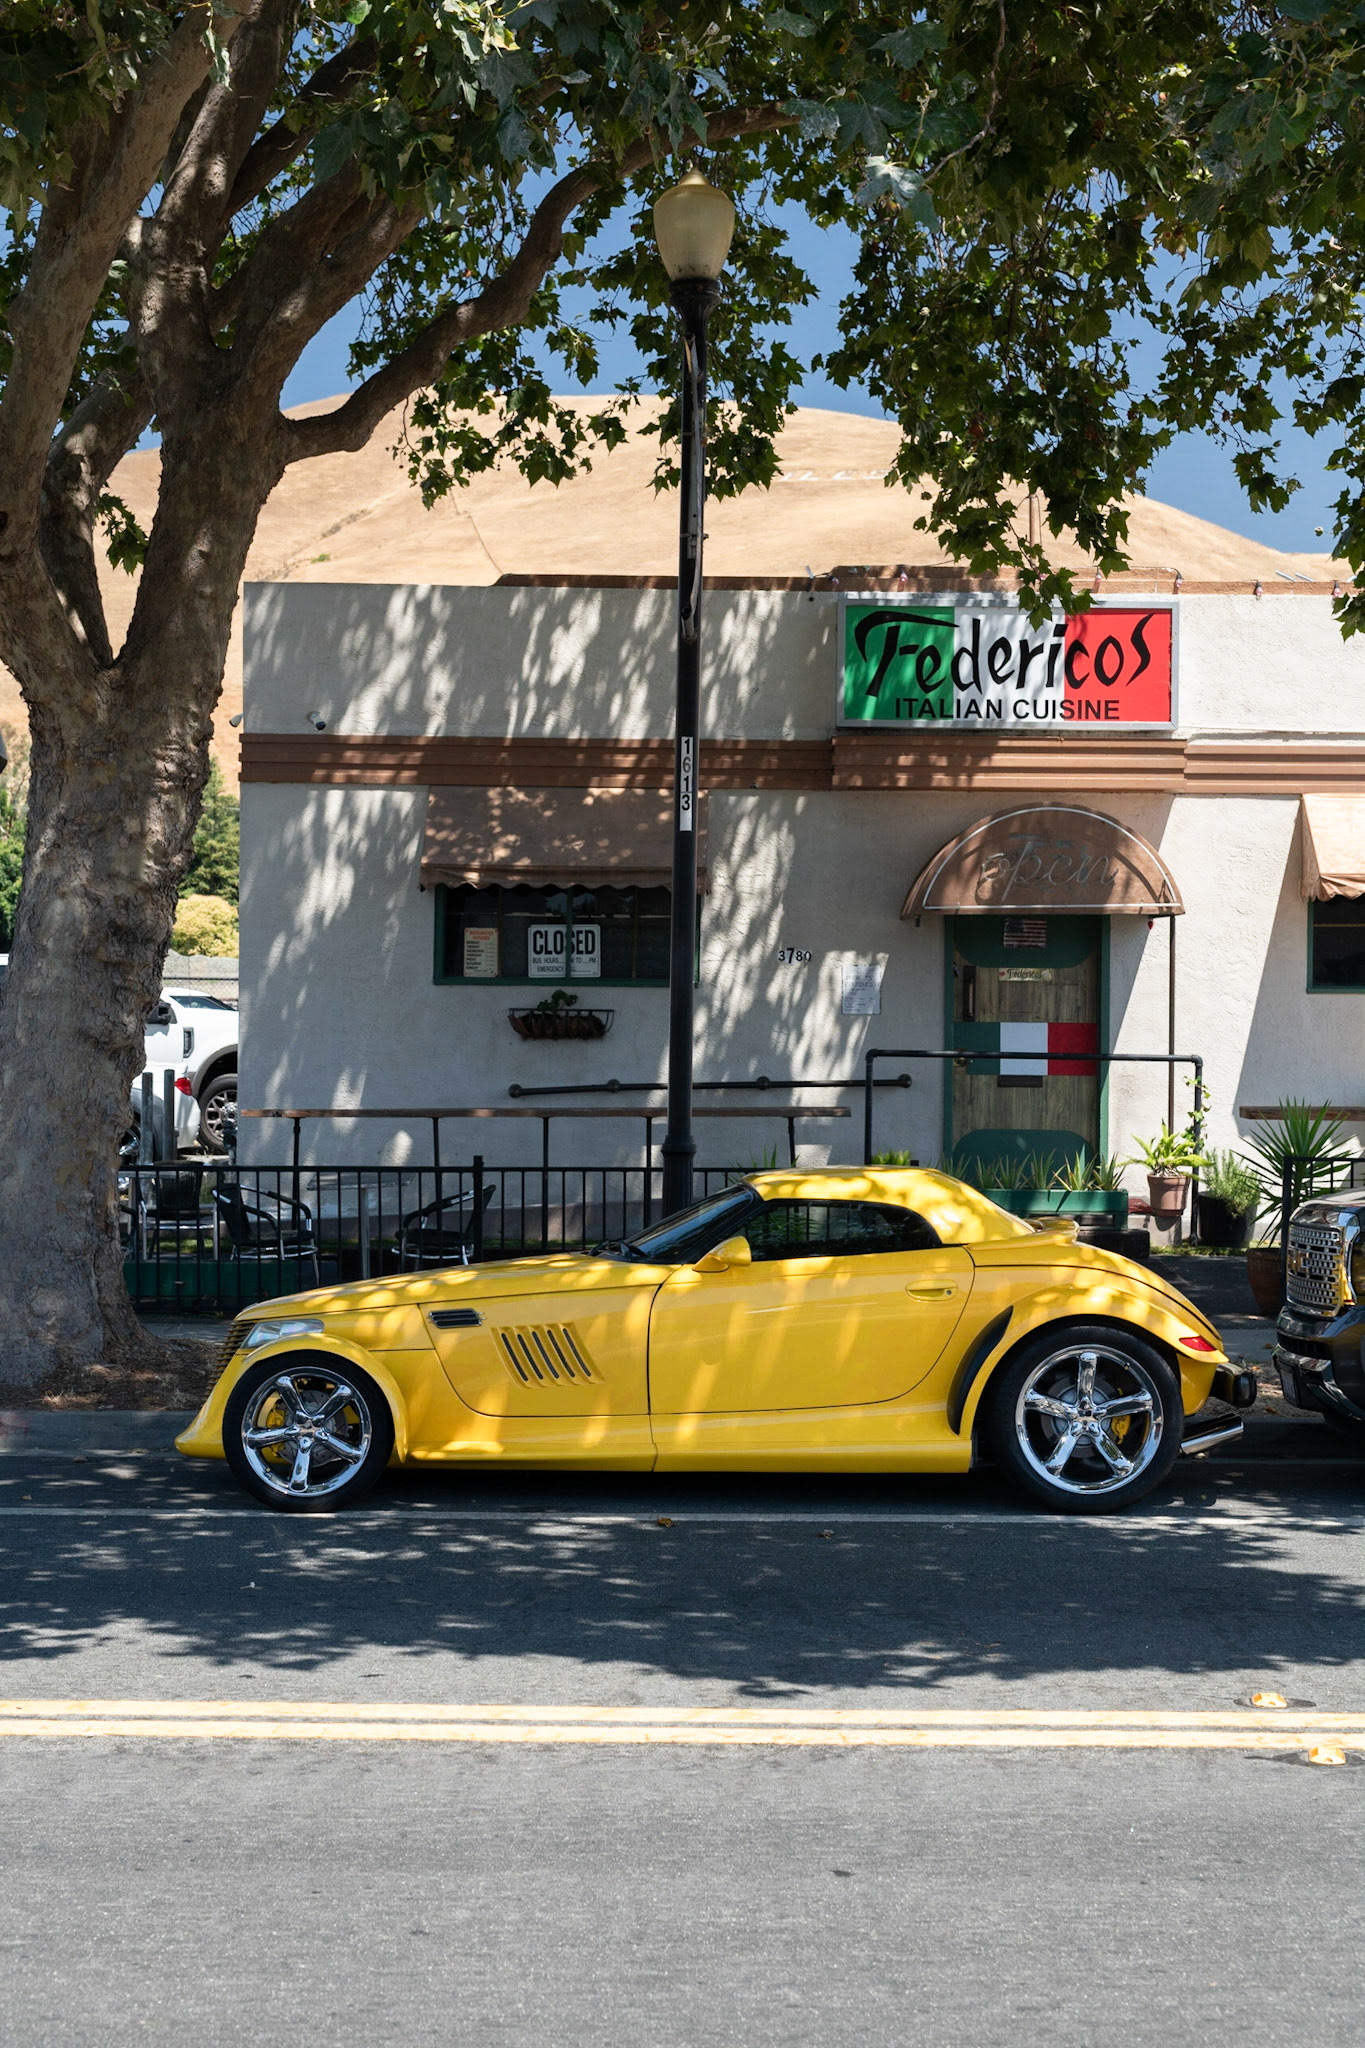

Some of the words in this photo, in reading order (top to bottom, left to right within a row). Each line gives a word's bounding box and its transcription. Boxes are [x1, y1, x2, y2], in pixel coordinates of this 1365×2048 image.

[895, 698, 1002, 719] ITALIAN
[1012, 698, 1120, 720] CUISINE
[681, 737, 692, 811] 1613
[778, 947, 812, 964] 3780
